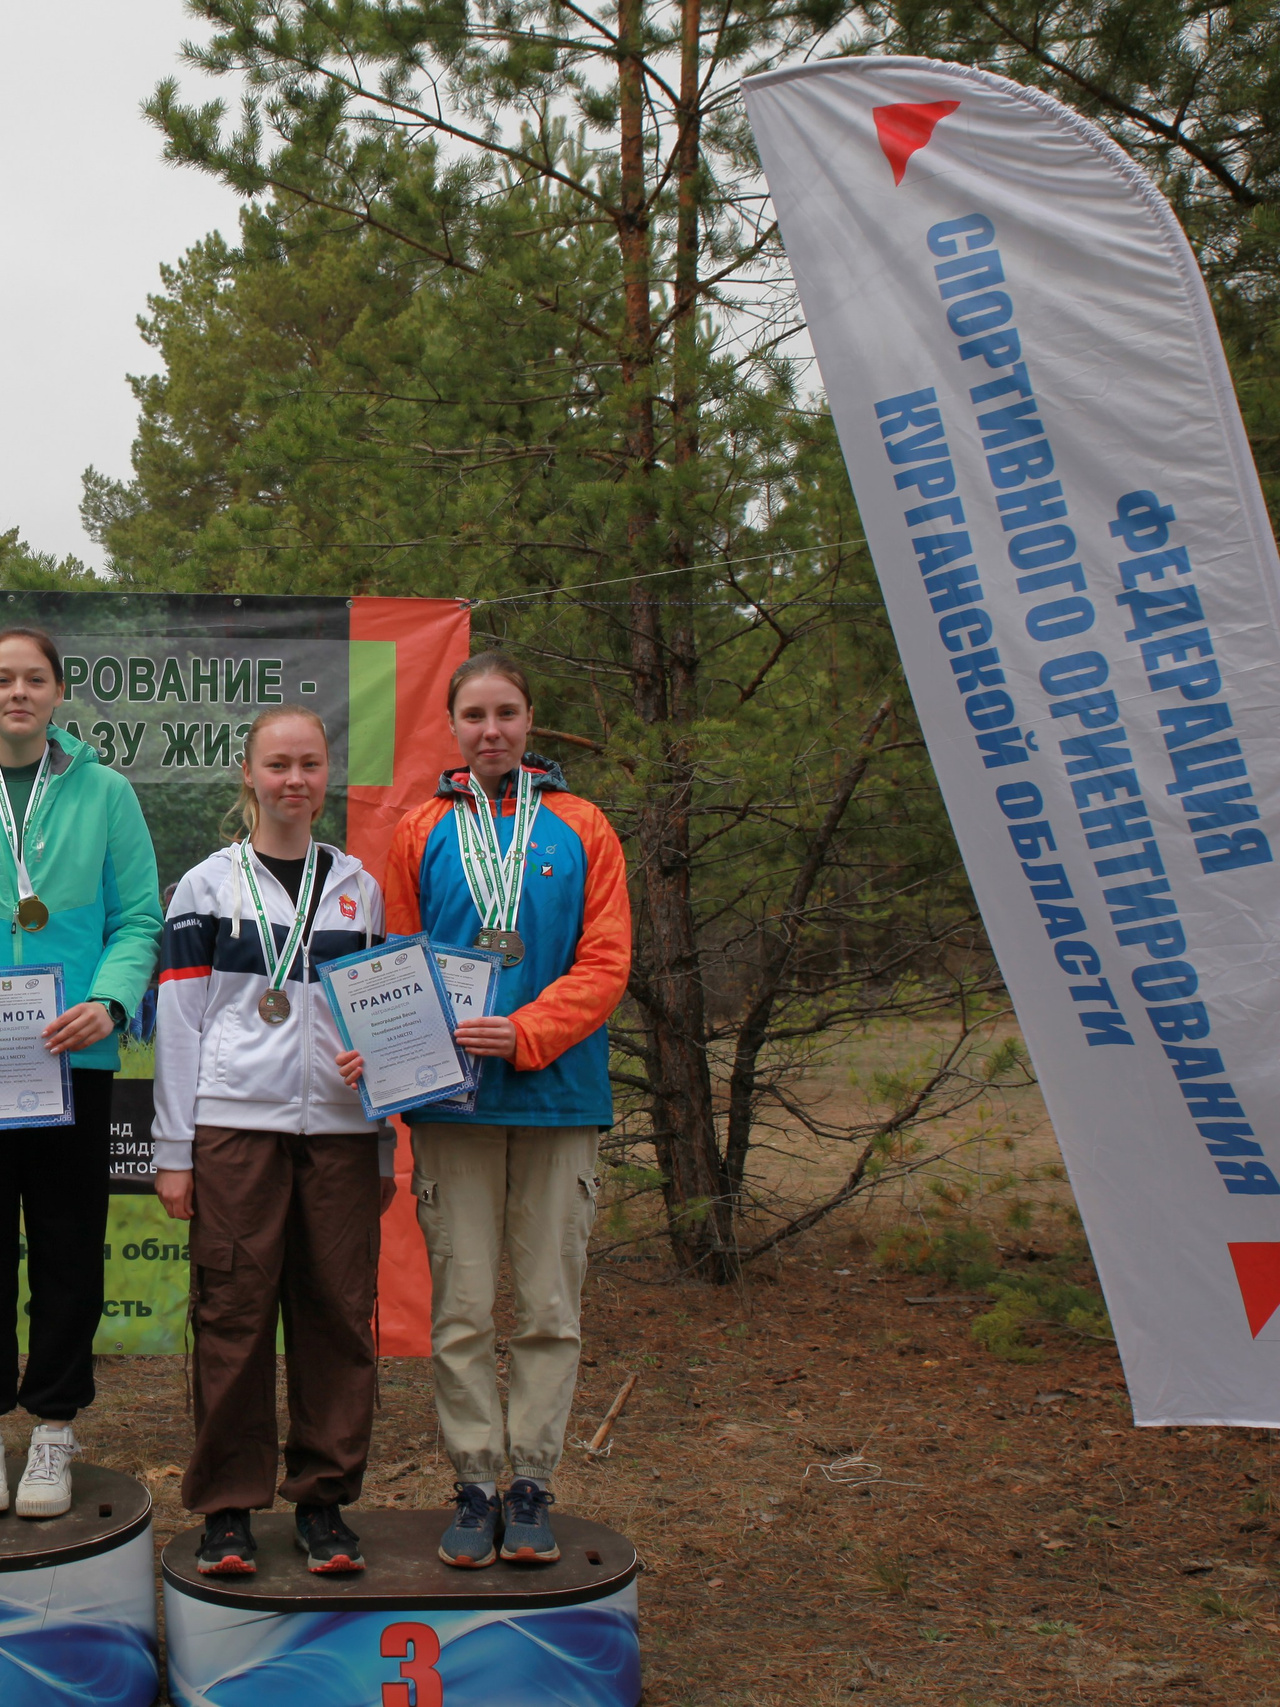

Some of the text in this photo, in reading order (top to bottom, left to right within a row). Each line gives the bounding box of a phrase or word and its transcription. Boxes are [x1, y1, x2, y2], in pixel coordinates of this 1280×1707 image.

[161, 721, 251, 767] ЖИЗ
[873, 386, 1135, 1047] КУРГАНСКОЙ ОБЛАСТИ
[925, 211, 1280, 1195] СПОРТИВНОГО ОРИЕНТИРОВАНИЯ
[1107, 489, 1274, 875] ФЕДЕРАЦИЯ
[349, 981, 423, 1012] ГРАМОТА
[380, 1621, 443, 1707] 3
